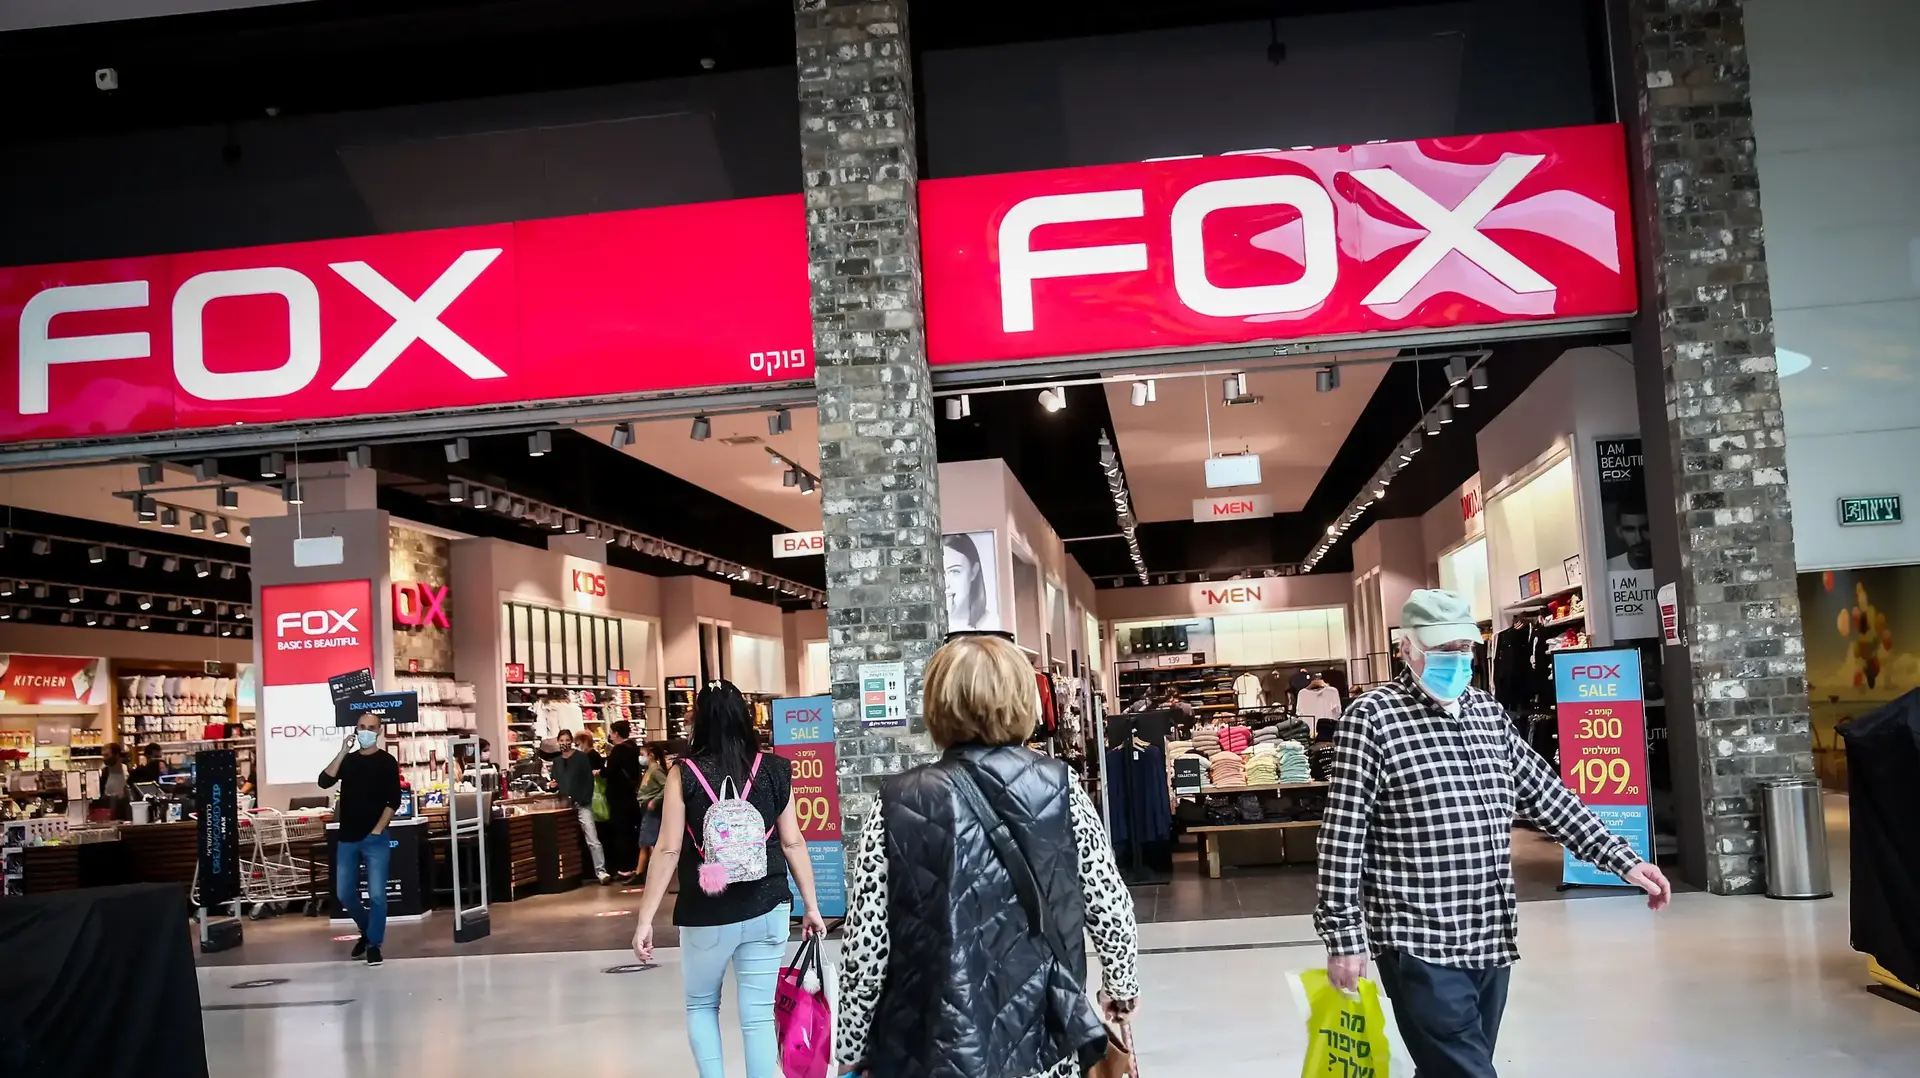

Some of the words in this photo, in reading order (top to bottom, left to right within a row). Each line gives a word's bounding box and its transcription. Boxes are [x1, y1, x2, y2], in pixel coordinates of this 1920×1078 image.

[998, 154, 1557, 333] FOX
[18, 247, 508, 415] FOX
[750, 349, 805, 377] פוקס
[1600, 444, 1603, 456] I
[1607, 443, 1625, 455] AM
[1602, 469, 1631, 479] FOX
[1213, 501, 1253, 515] MEN
[1860, 498, 1898, 521] יציאה
[784, 536, 823, 551] BAB
[572, 568, 606, 597] KIDS
[1612, 578, 1616, 590] I
[1619, 577, 1637, 590] AM
[1207, 586, 1262, 605] MEN
[392, 583, 451, 629] OX
[1615, 603, 1643, 614] FOX
[276, 607, 359, 638] FOX
[277, 640, 302, 651] BASIC
[304, 639, 313, 649] IS
[314, 637, 359, 649] BEAUTIFUL
[1571, 664, 1621, 681] FOX
[13, 674, 67, 688] KITCHEN
[1578, 683, 1618, 698] SALE
[350, 701, 389, 711] DREAMCARD
[389, 700, 403, 708] VIP
[785, 708, 823, 724] FOX
[790, 726, 820, 740] SALE
[1582, 745, 1621, 755] ומשלמים
[213, 784, 221, 805] VIP
[793, 785, 822, 794] ומשלמים
[213, 805, 221, 874] DREAMCARD
[389, 840, 399, 848] IP
[1340, 1010, 1366, 1033] מה
[1319, 1028, 1371, 1059] סיפור
